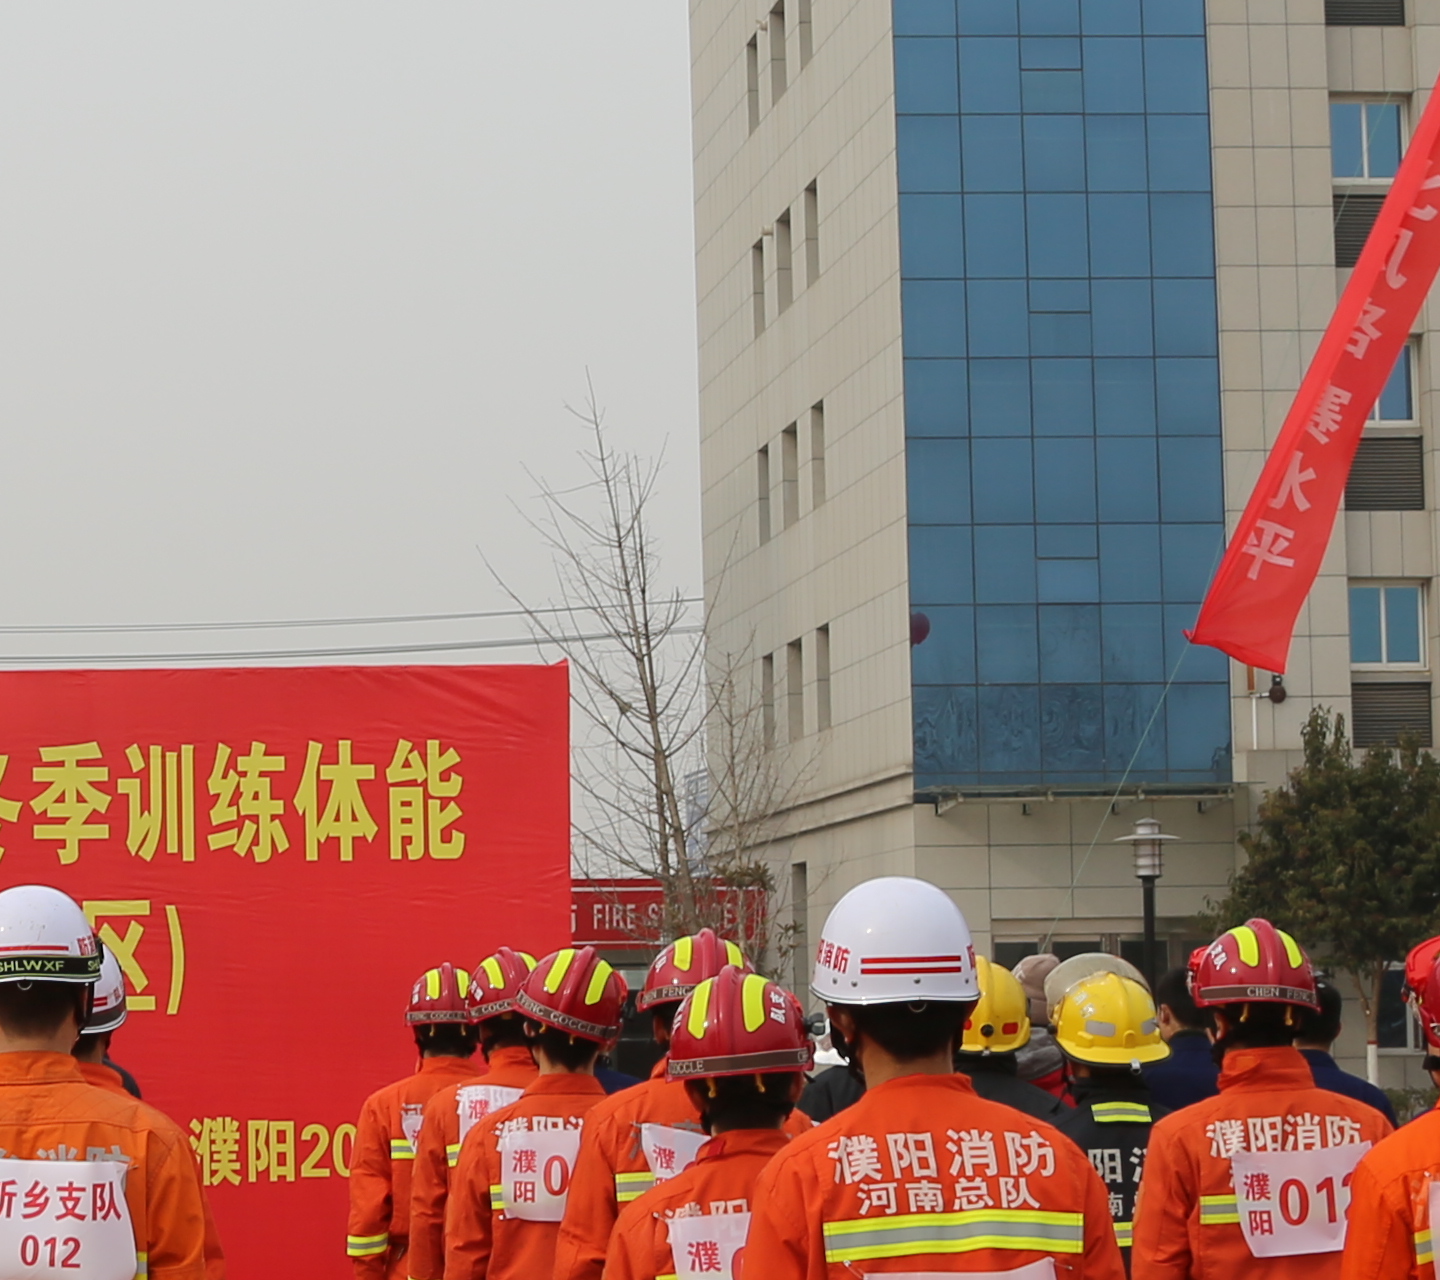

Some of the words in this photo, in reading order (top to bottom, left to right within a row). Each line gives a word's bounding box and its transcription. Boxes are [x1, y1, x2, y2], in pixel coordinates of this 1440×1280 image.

[828, 1129, 1057, 1185] 濮阳消防
[1206, 1111, 1362, 1158] 濮阳消防
[857, 1176, 1041, 1216] 河南总队
[1243, 1171, 1274, 1237] 濮阳
[19, 1235, 82, 1269] 012
